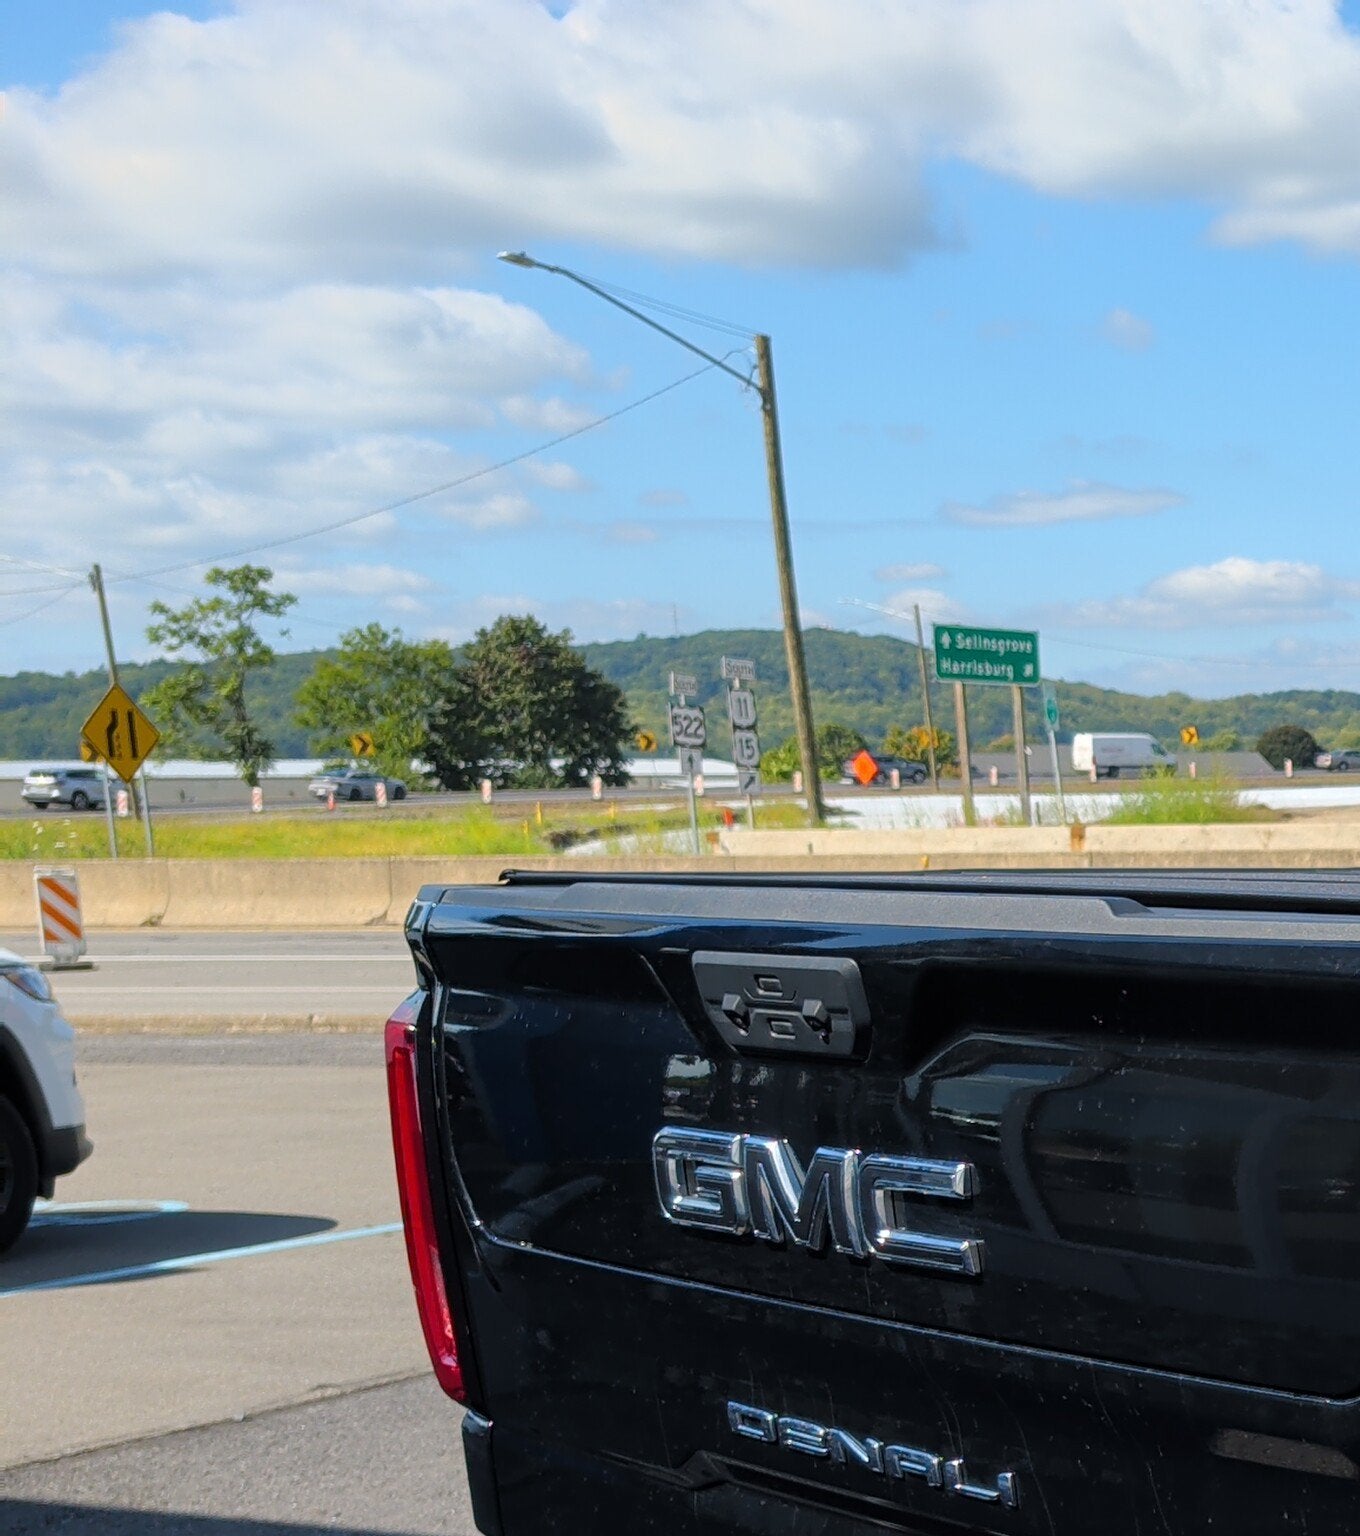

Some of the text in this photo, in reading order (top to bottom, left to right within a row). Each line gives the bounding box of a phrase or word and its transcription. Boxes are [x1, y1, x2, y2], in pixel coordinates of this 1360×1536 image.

[955, 632, 1033, 656] Selinsgrove
[941, 658, 1013, 681] Harrisburg
[738, 698, 750, 717] 11
[673, 715, 703, 738] 522
[738, 738, 755, 760] 15
[653, 1125, 986, 1276] GMC
[726, 1399, 1019, 1509] DENALI
